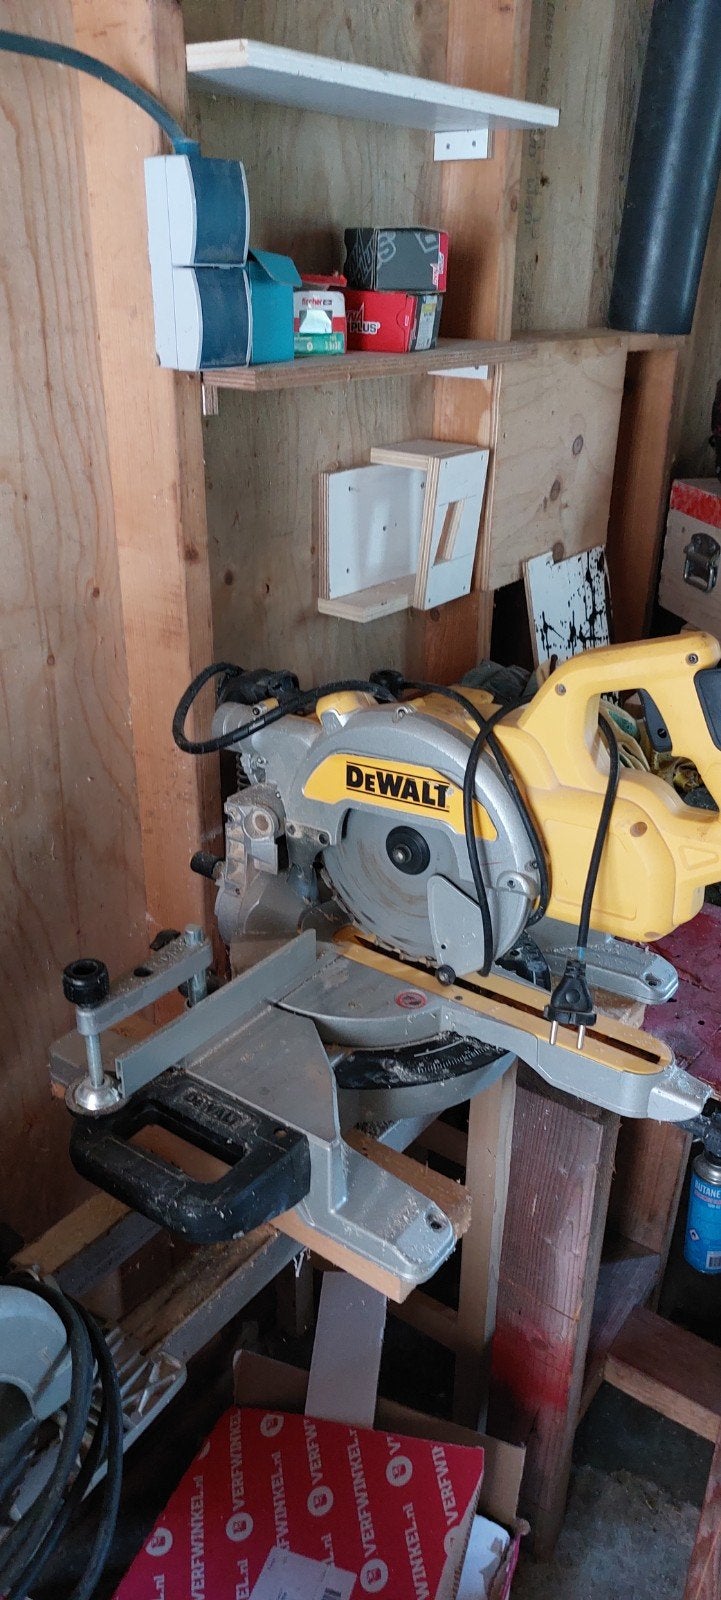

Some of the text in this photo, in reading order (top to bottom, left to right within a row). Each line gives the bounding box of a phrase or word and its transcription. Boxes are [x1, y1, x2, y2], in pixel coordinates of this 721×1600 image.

[351, 322, 377, 333] PLUS
[694, 1179, 721, 1199] BUTANE
[303, 1419, 324, 1486] VERFW
[235, 1559, 250, 1600] EL.nl
